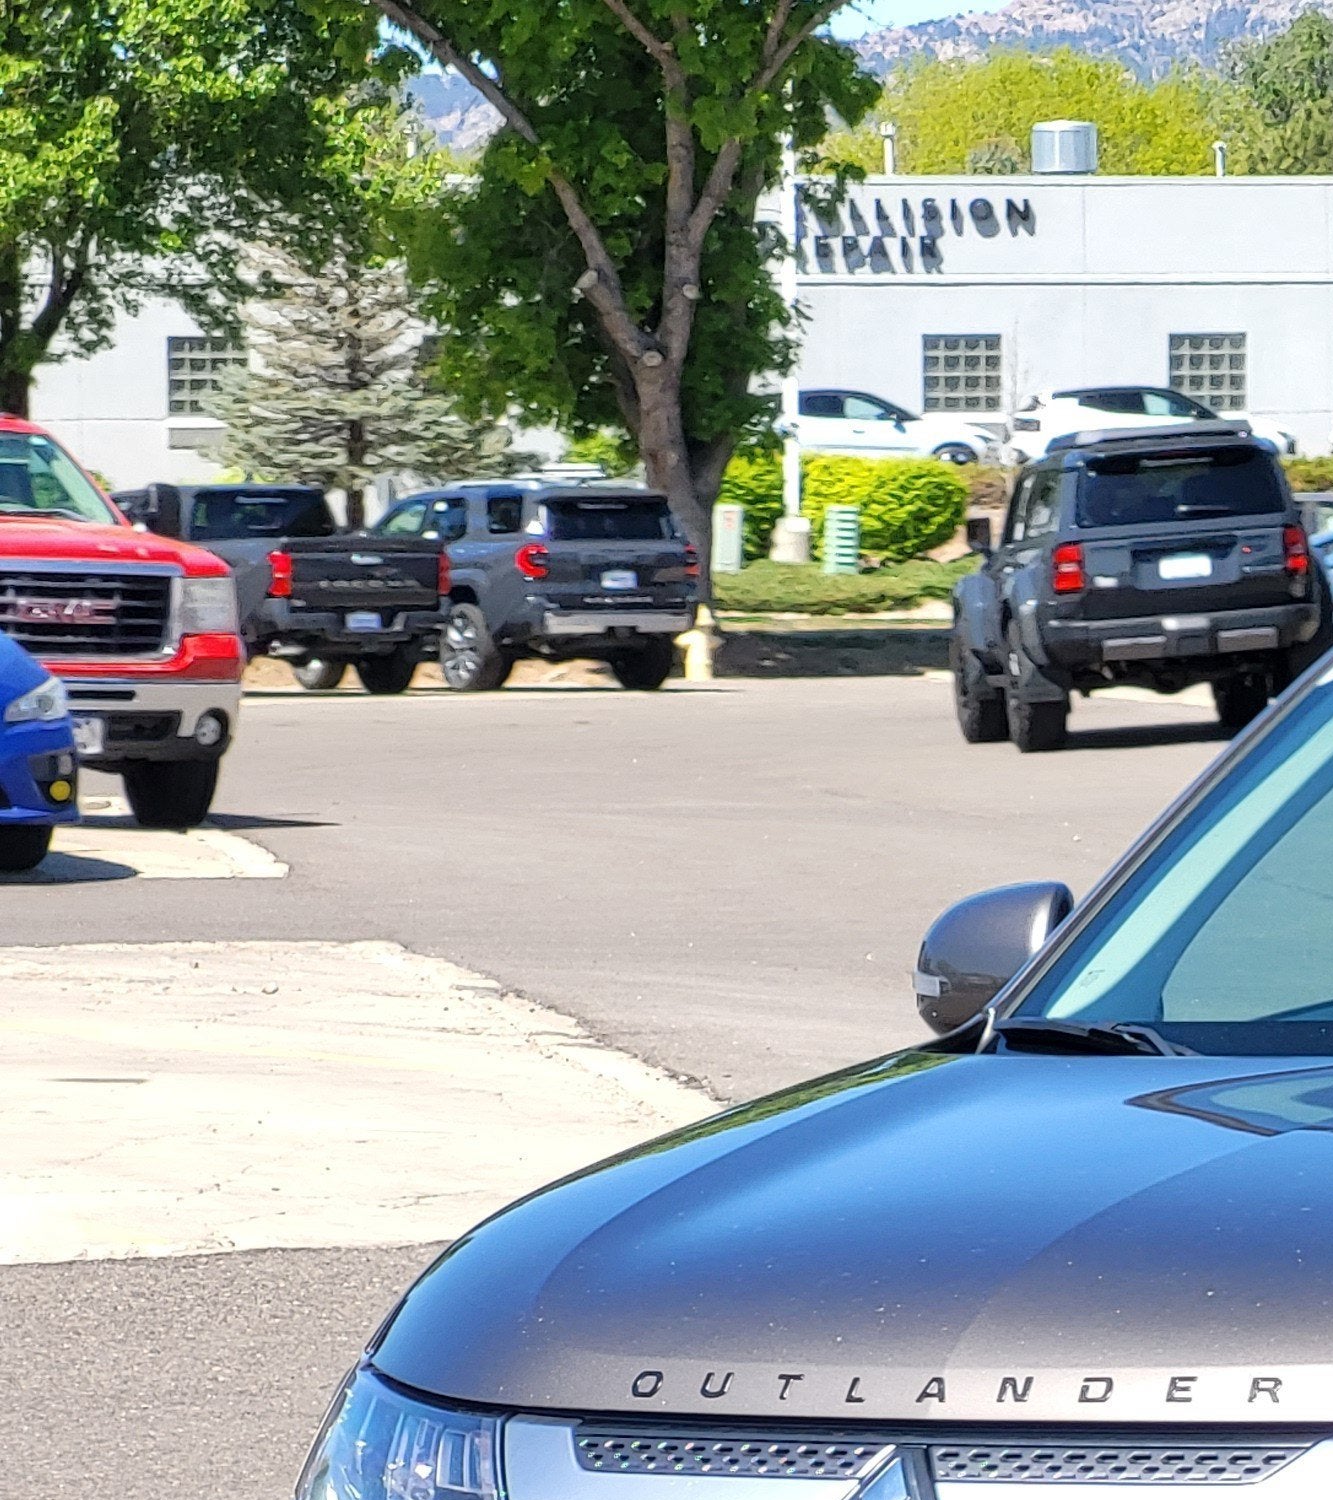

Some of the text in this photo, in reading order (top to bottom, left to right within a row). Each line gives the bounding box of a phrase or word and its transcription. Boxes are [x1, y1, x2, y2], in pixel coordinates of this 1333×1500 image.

[795, 197, 1034, 231] LLISION
[795, 235, 942, 267] EPAIR
[631, 1370, 1283, 1403] OUTLANDER
